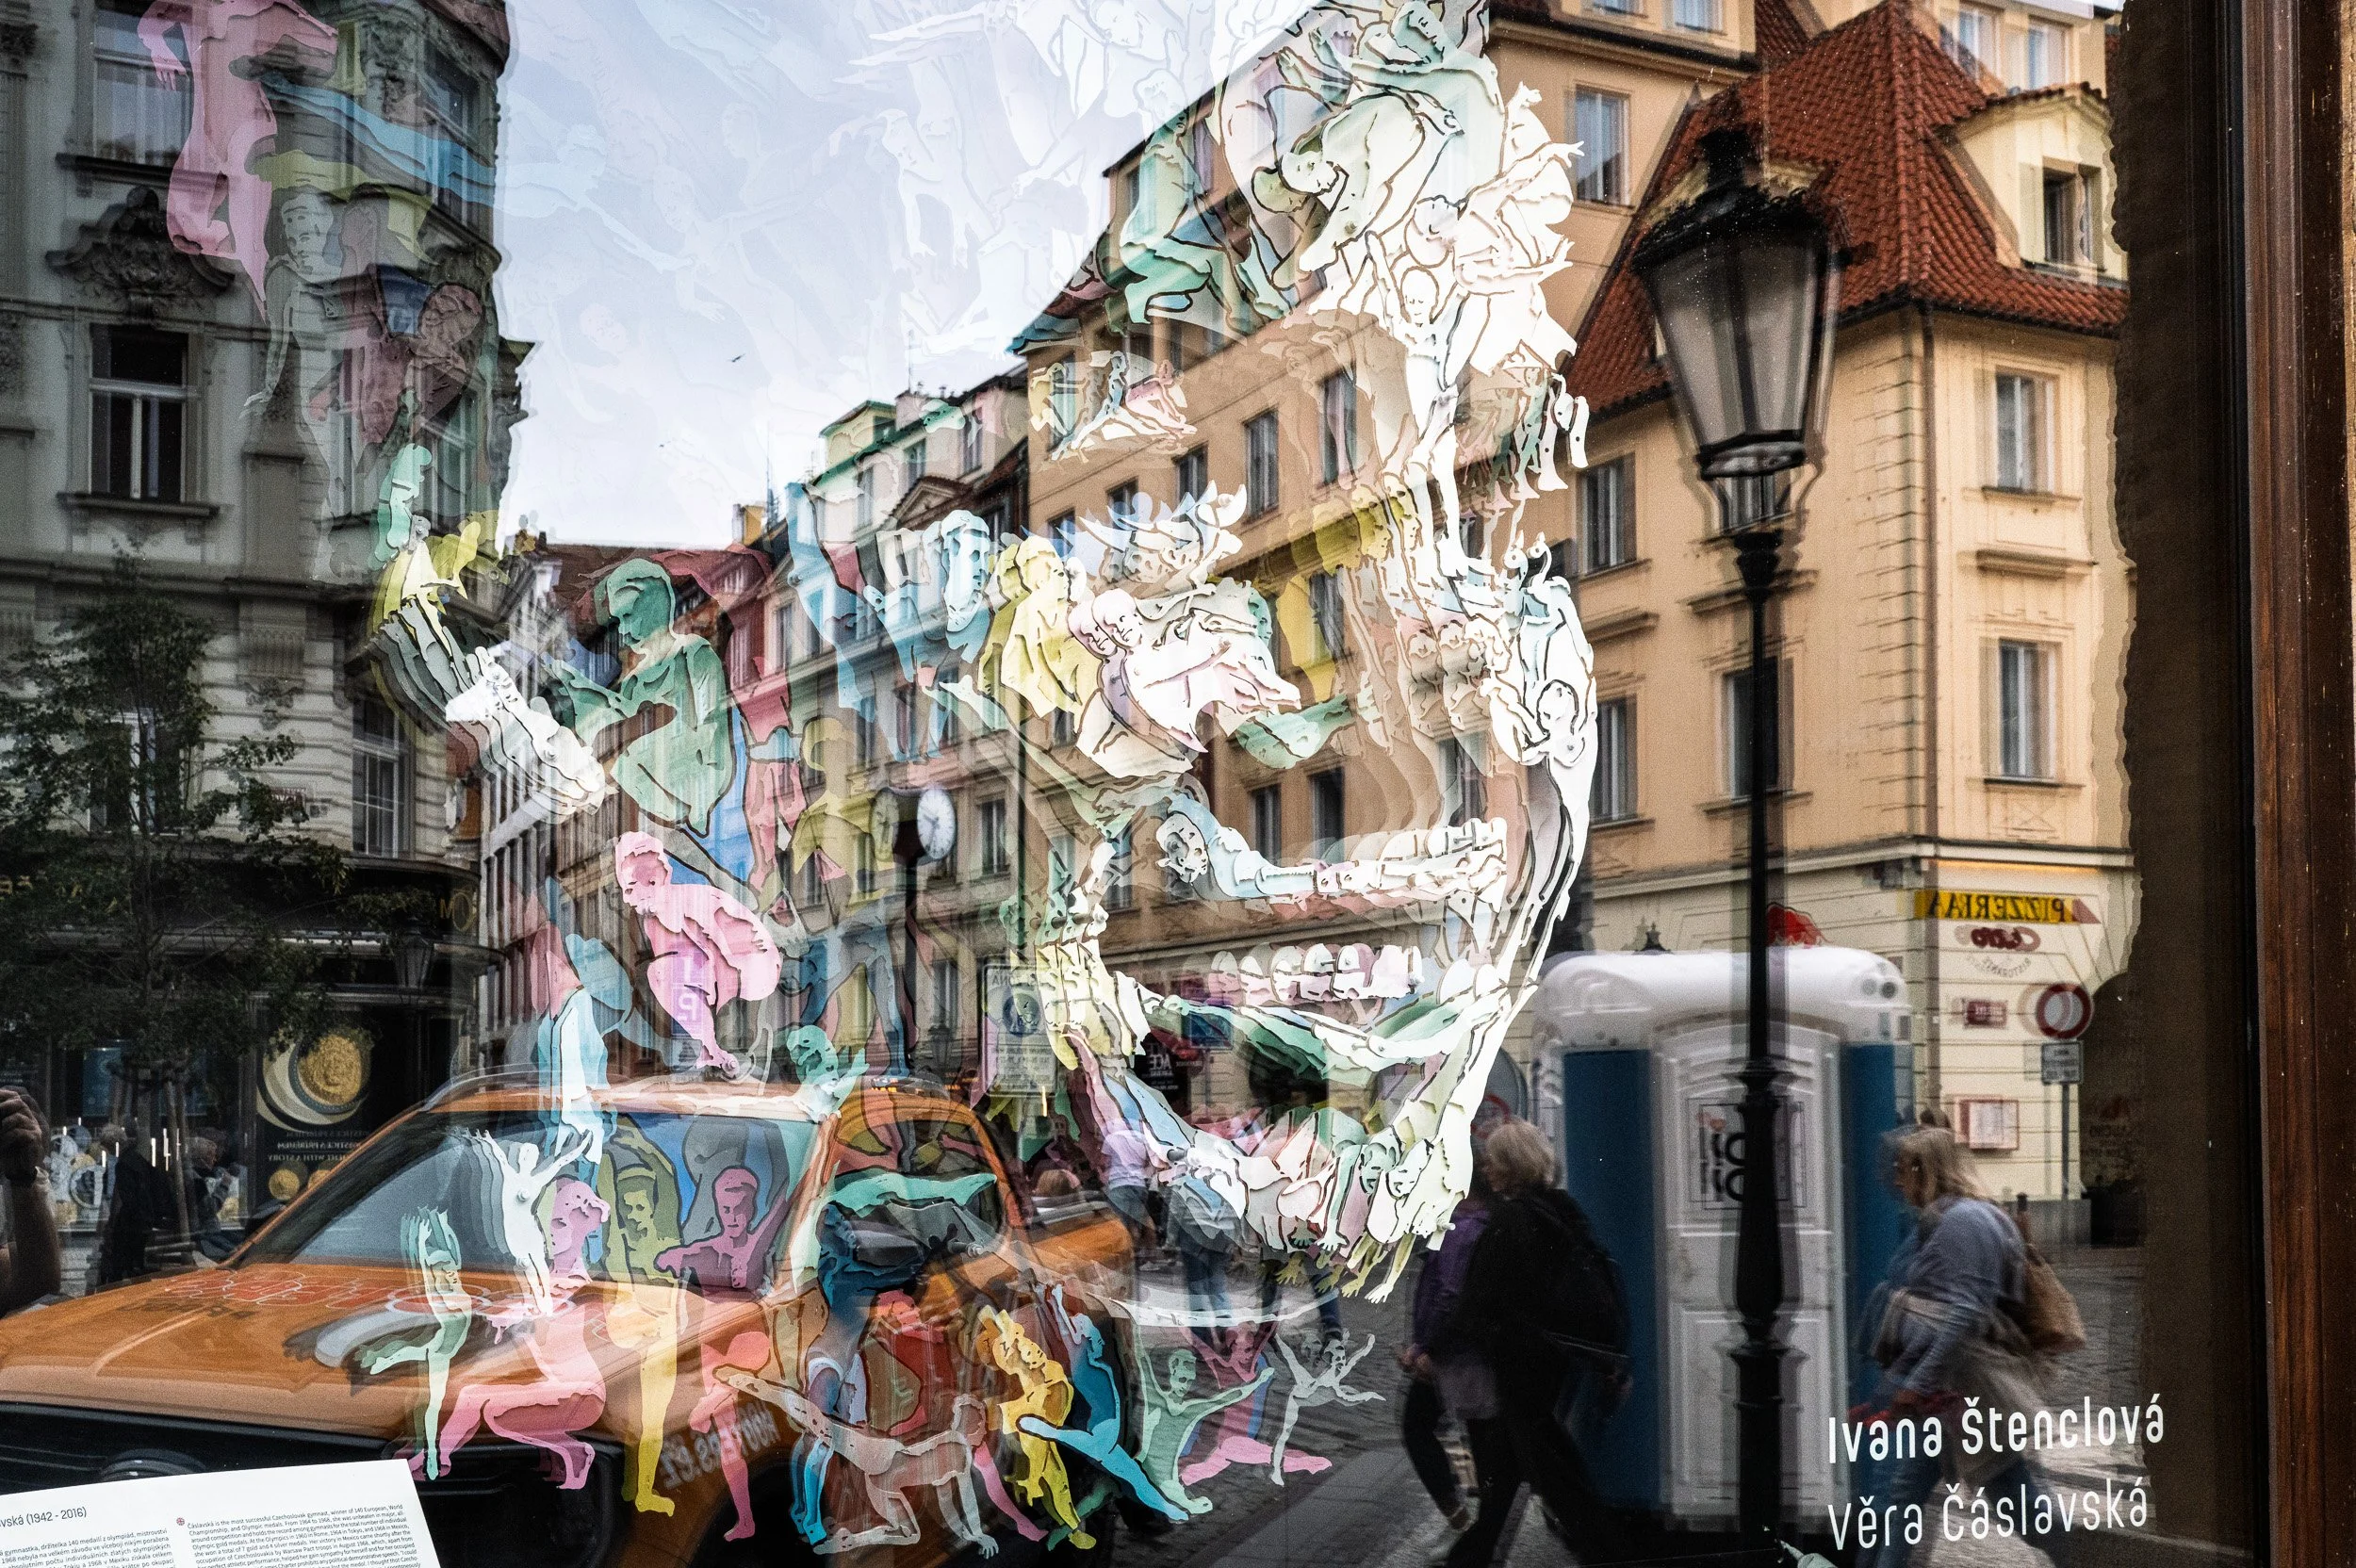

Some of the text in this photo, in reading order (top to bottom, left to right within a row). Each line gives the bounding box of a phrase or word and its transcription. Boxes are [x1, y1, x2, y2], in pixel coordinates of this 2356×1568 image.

[1828, 1394, 2165, 1463] Ivana Štenclová
[26, 1511, 53, 1525] (1942
[60, 1506, 86, 1519] 2016)
[1828, 1477, 2147, 1550] Věra Čáslavská
